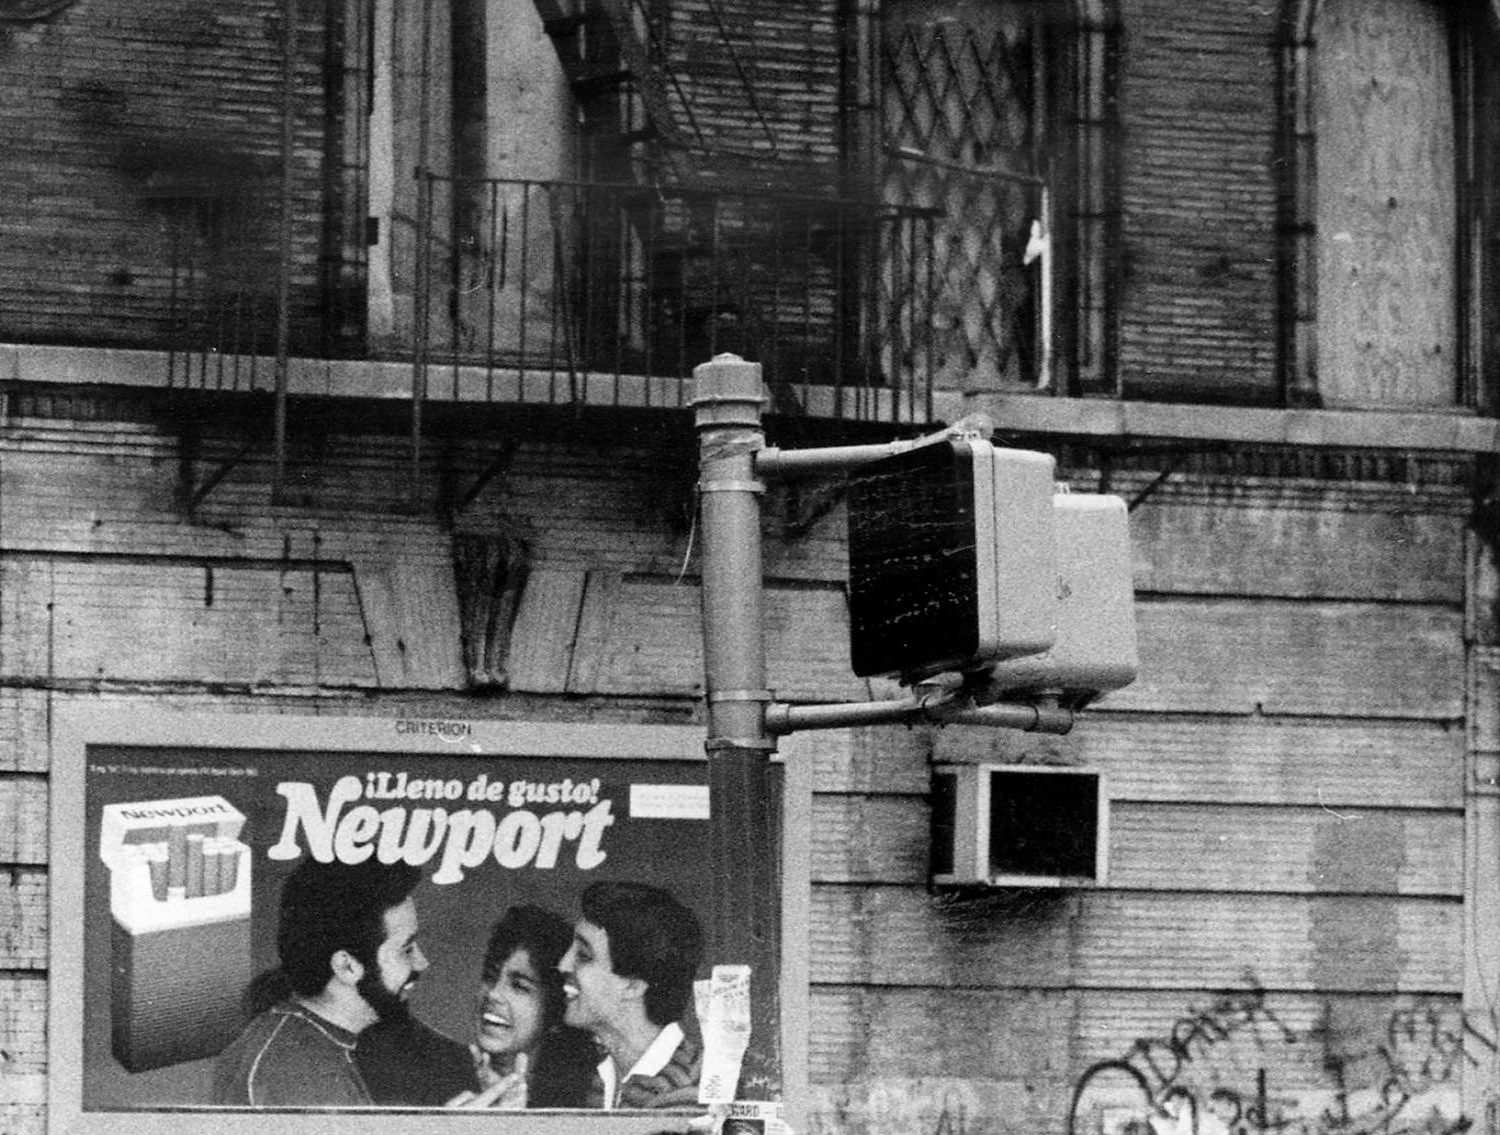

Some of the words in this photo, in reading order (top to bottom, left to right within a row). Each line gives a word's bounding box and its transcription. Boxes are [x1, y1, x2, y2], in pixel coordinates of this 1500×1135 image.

[395, 720, 472, 737] CRITERION
[467, 774, 503, 802] de
[507, 778, 601, 807] gusto!
[120, 803, 230, 820] Newport
[267, 775, 615, 885] Newport
